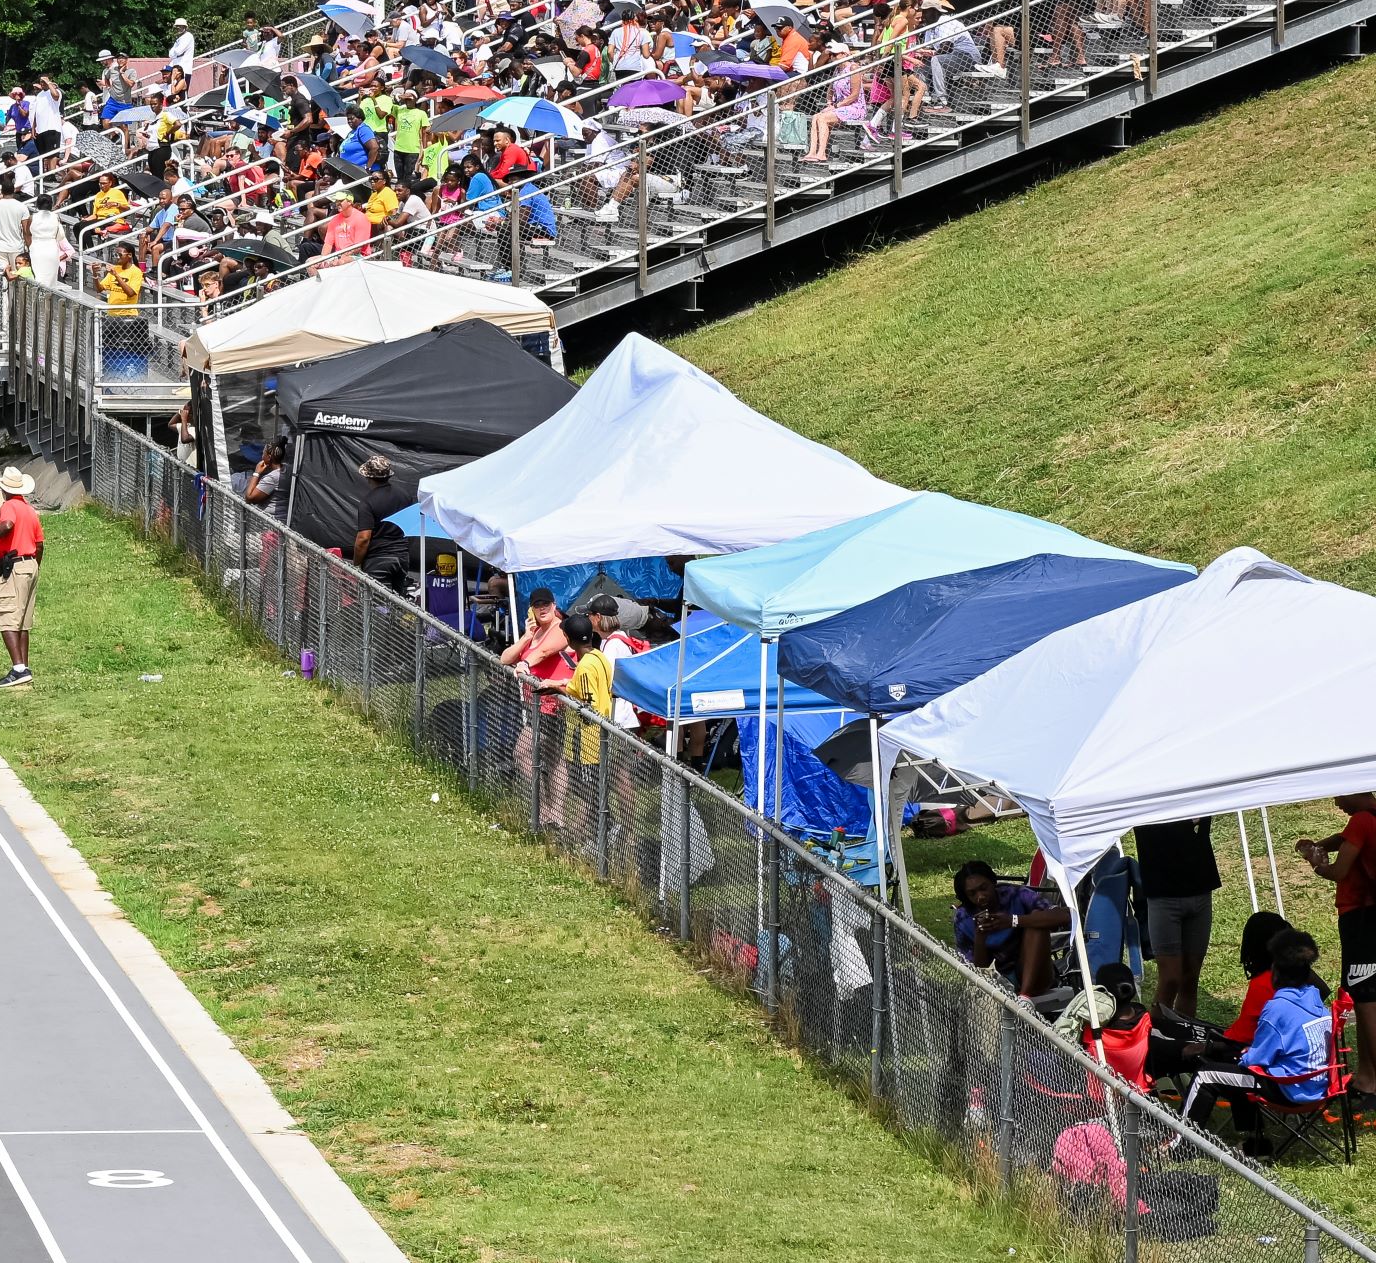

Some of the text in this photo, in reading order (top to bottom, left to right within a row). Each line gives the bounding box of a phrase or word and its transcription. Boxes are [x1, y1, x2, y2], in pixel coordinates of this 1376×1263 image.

[314, 412, 370, 430] Academy
[778, 617, 805, 625] QUEST
[87, 1170, 174, 1188] 8
